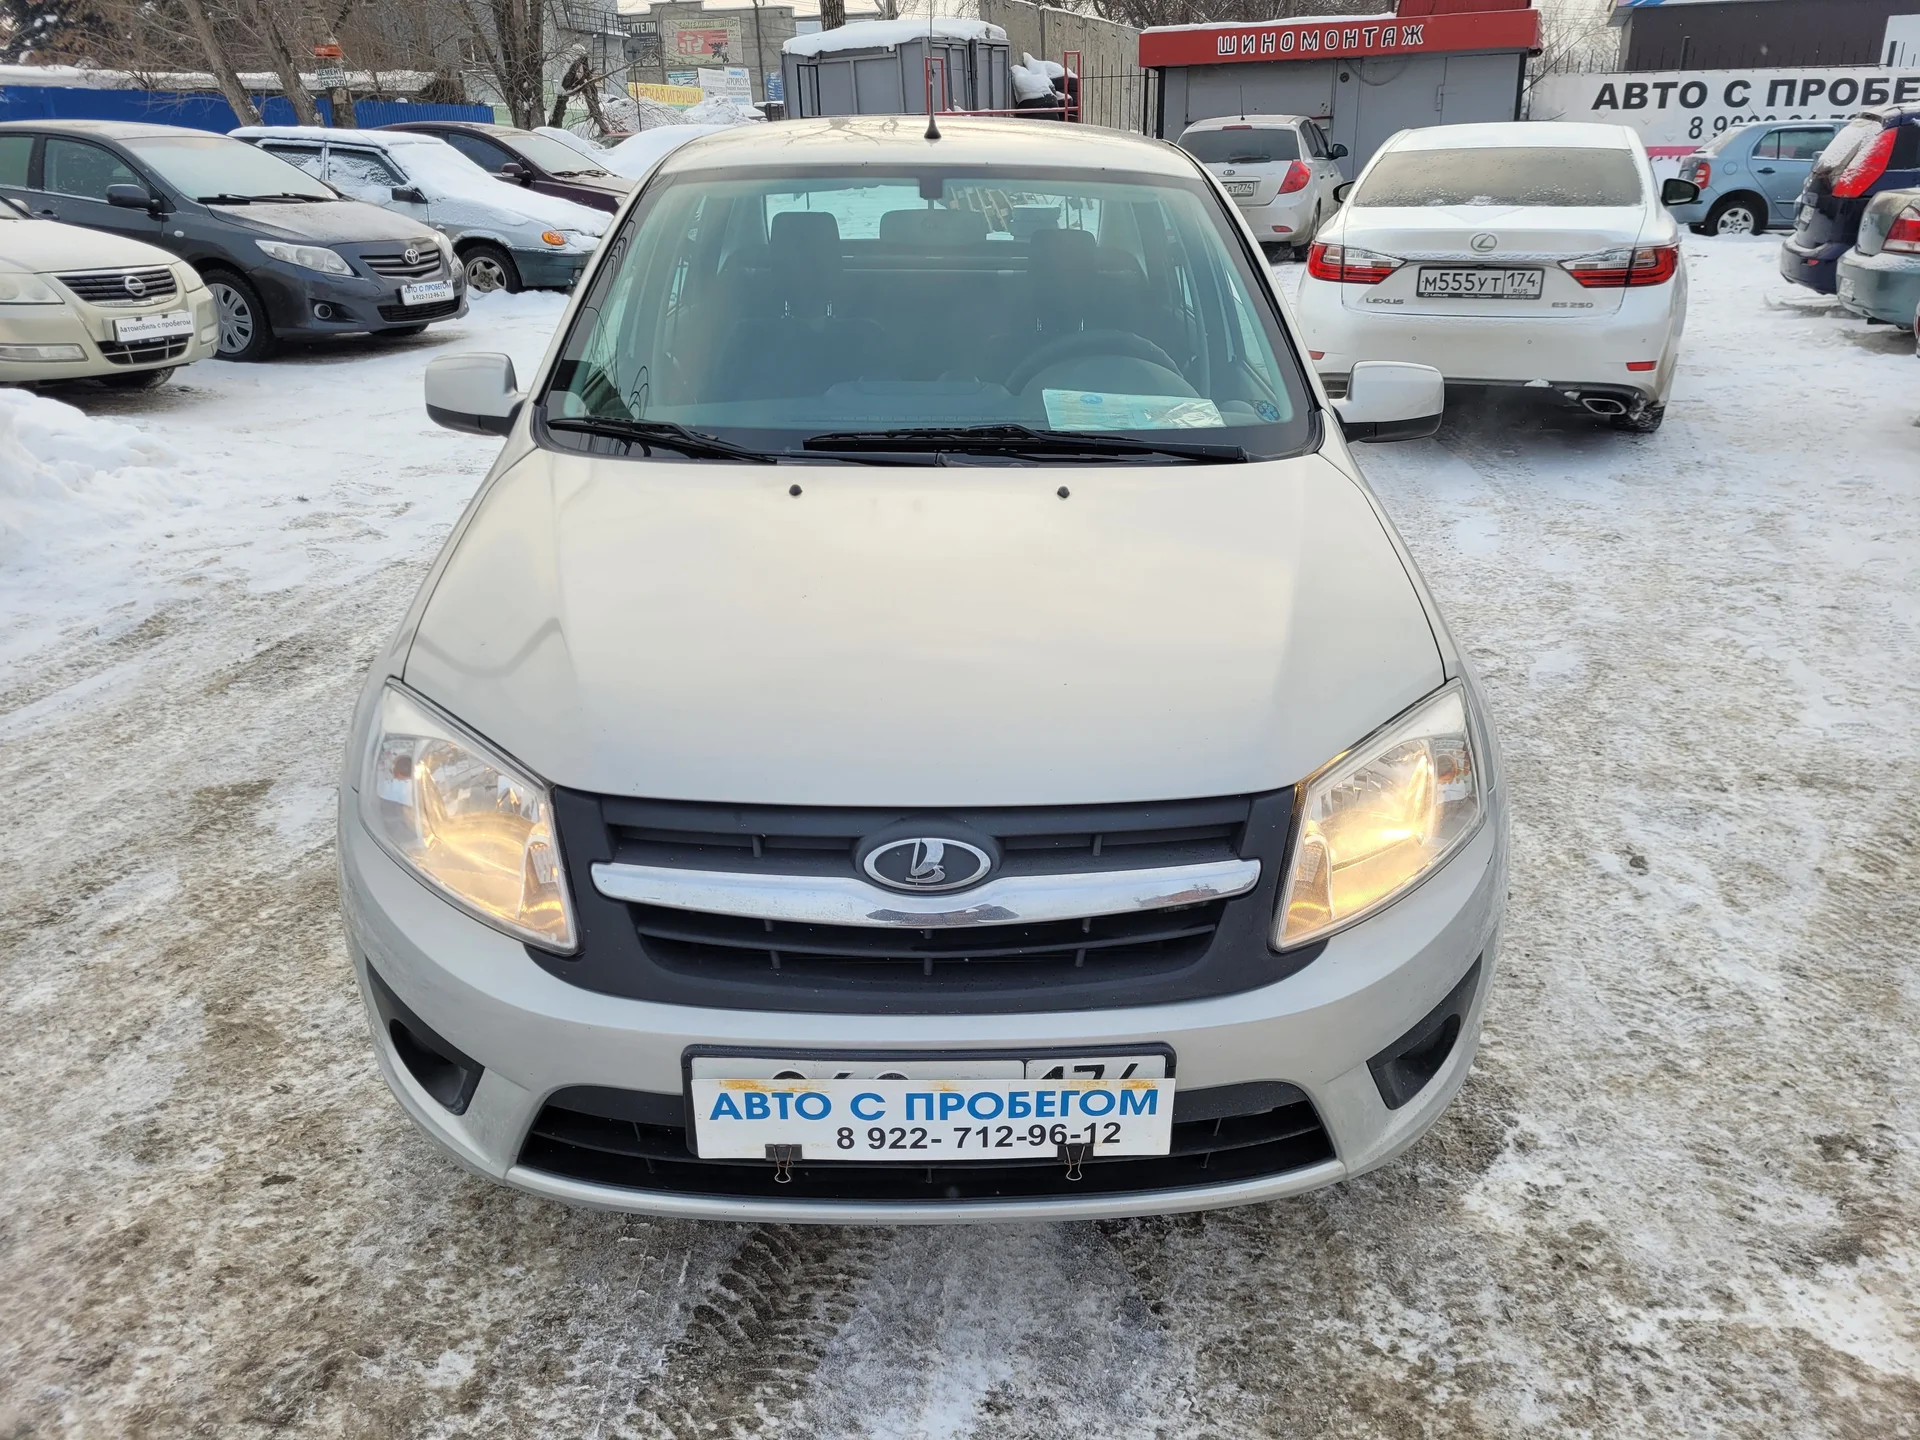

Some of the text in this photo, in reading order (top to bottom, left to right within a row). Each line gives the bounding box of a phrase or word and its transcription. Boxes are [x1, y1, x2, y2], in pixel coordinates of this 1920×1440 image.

[1217, 24, 1424, 55] ШИНОМОНТАЖ
[1591, 80, 1708, 110] АВТО
[1723, 80, 1751, 108] С
[1688, 116, 1703, 139] 8
[425, 282, 451, 291] ПРОБЕГОМ
[1507, 272, 1535, 287] 174
[120, 323, 156, 333] Автомобиль
[162, 319, 191, 328] пробегом
[709, 1089, 1158, 1121] АВТО С ПРОБЕГОМ
[836, 1127, 855, 1150] 8
[953, 1122, 1121, 1149] 712-96-12
